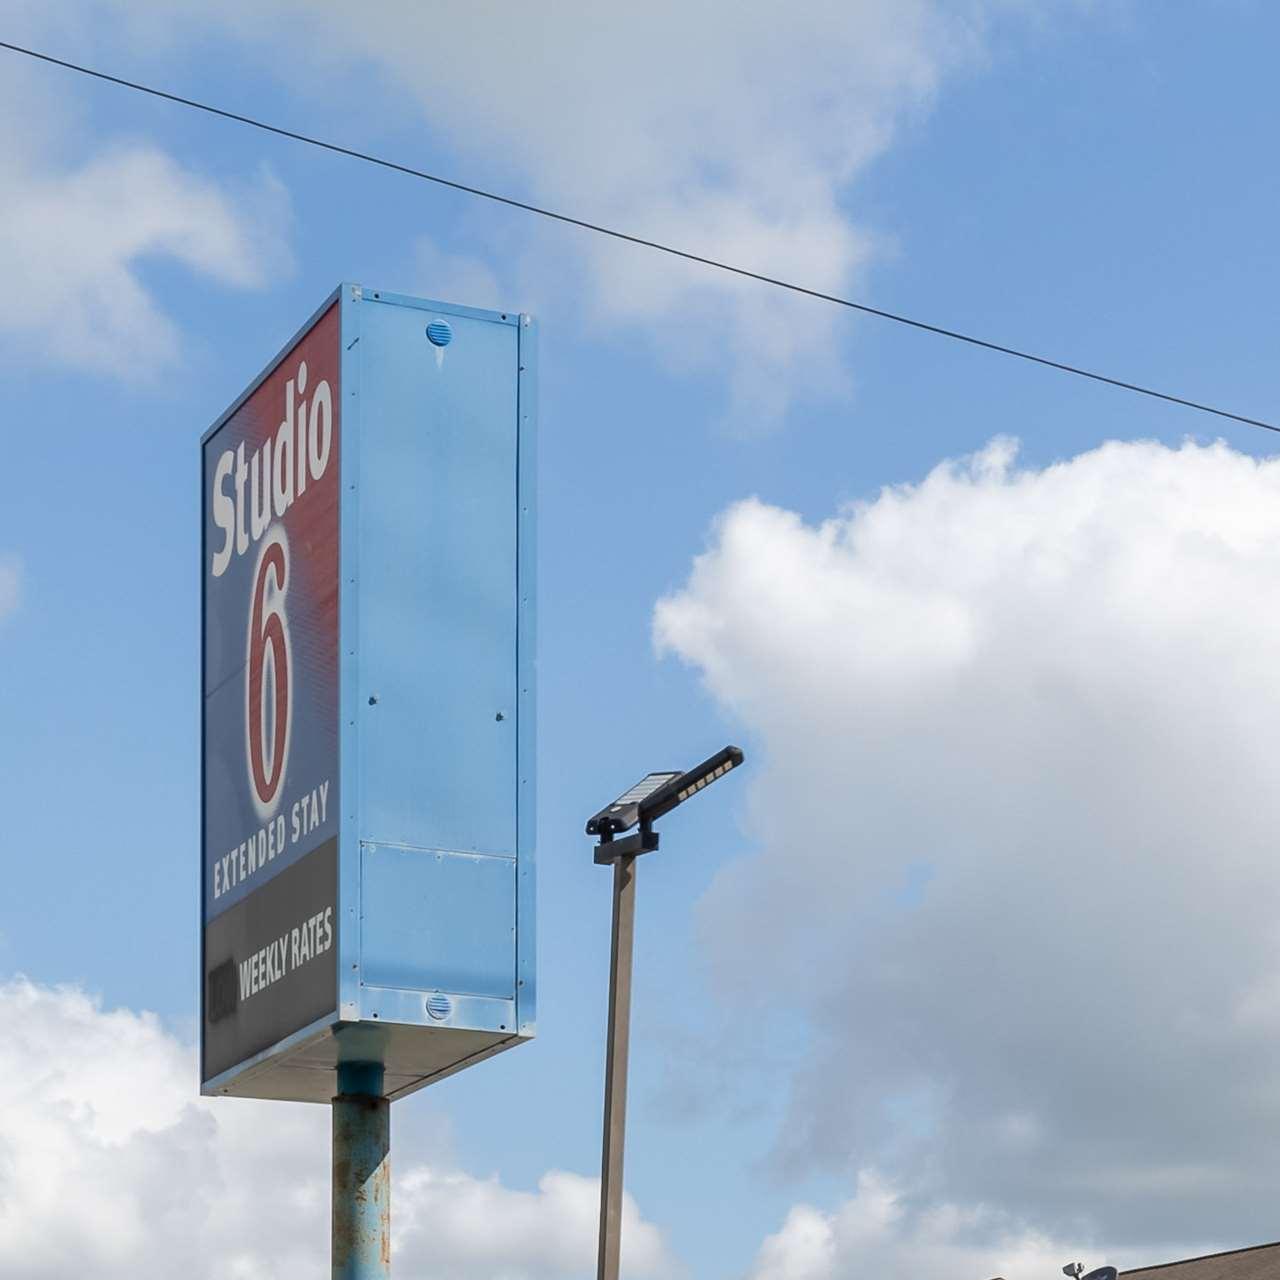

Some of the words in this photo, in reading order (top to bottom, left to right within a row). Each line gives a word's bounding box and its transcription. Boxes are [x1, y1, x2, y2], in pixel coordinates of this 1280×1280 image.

[212, 360, 332, 577] Studio
[246, 534, 289, 810] 6
[214, 815, 286, 899] EXTENDED
[291, 780, 329, 843] STAY
[239, 934, 288, 1001] WEEKLY
[292, 906, 332, 970] RATES
